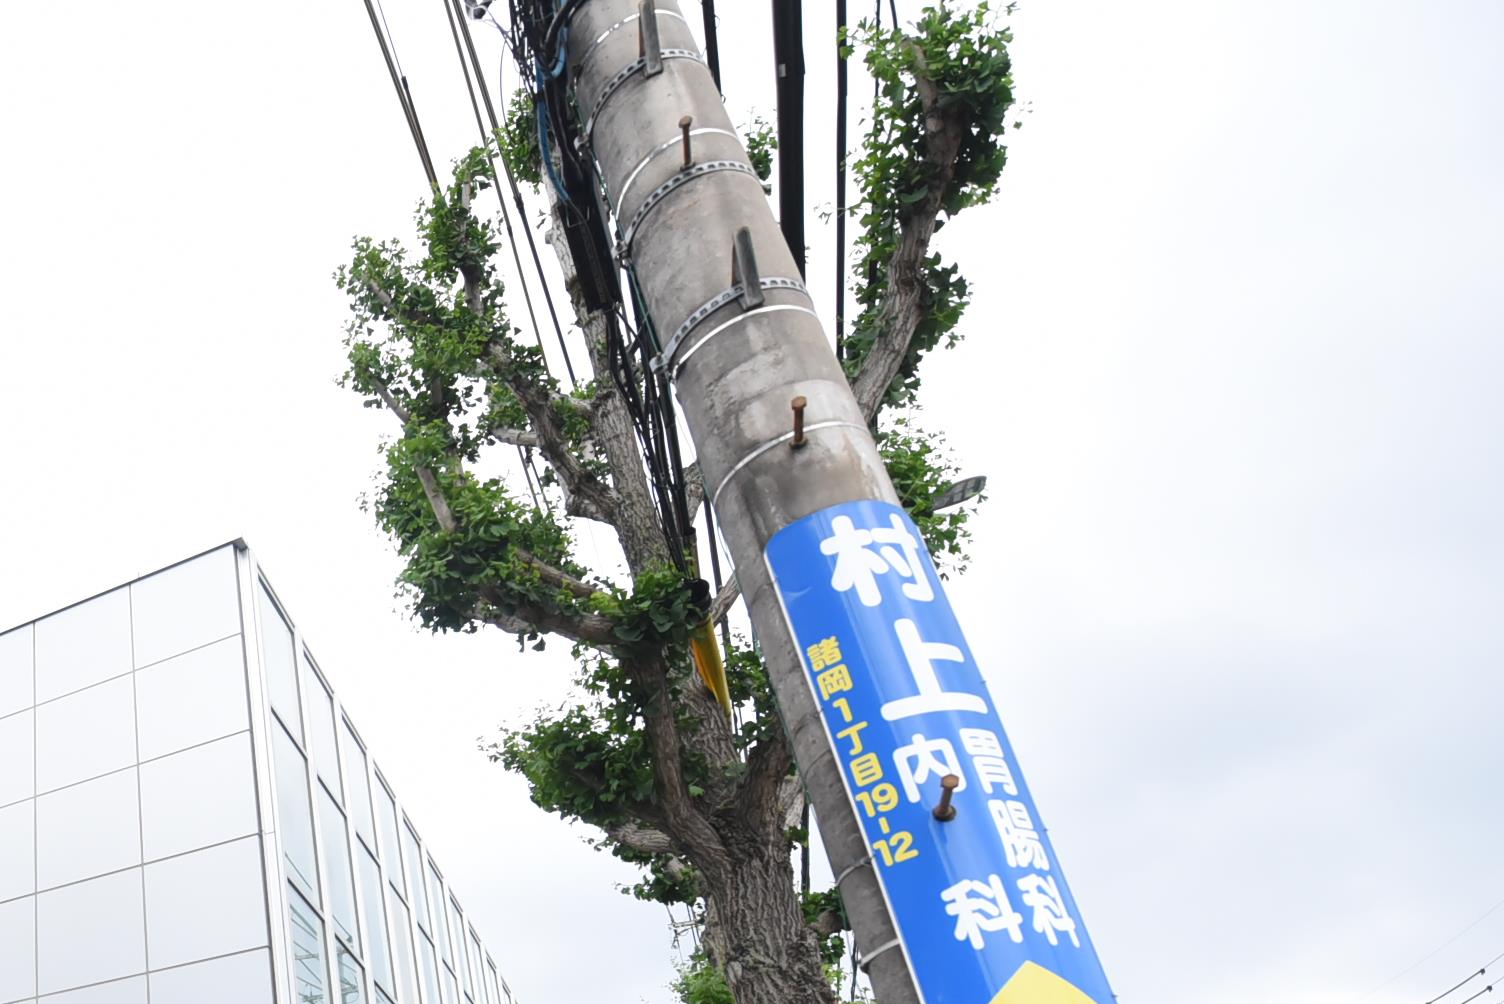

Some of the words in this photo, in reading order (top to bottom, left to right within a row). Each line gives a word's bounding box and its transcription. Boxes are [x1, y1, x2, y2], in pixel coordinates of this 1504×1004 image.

[819, 514, 989, 722] 村上
[806, 635, 920, 868] 諸岡1丁目19-12
[892, 732, 1024, 951] 内科
[958, 726, 1082, 949] 胃腸科
